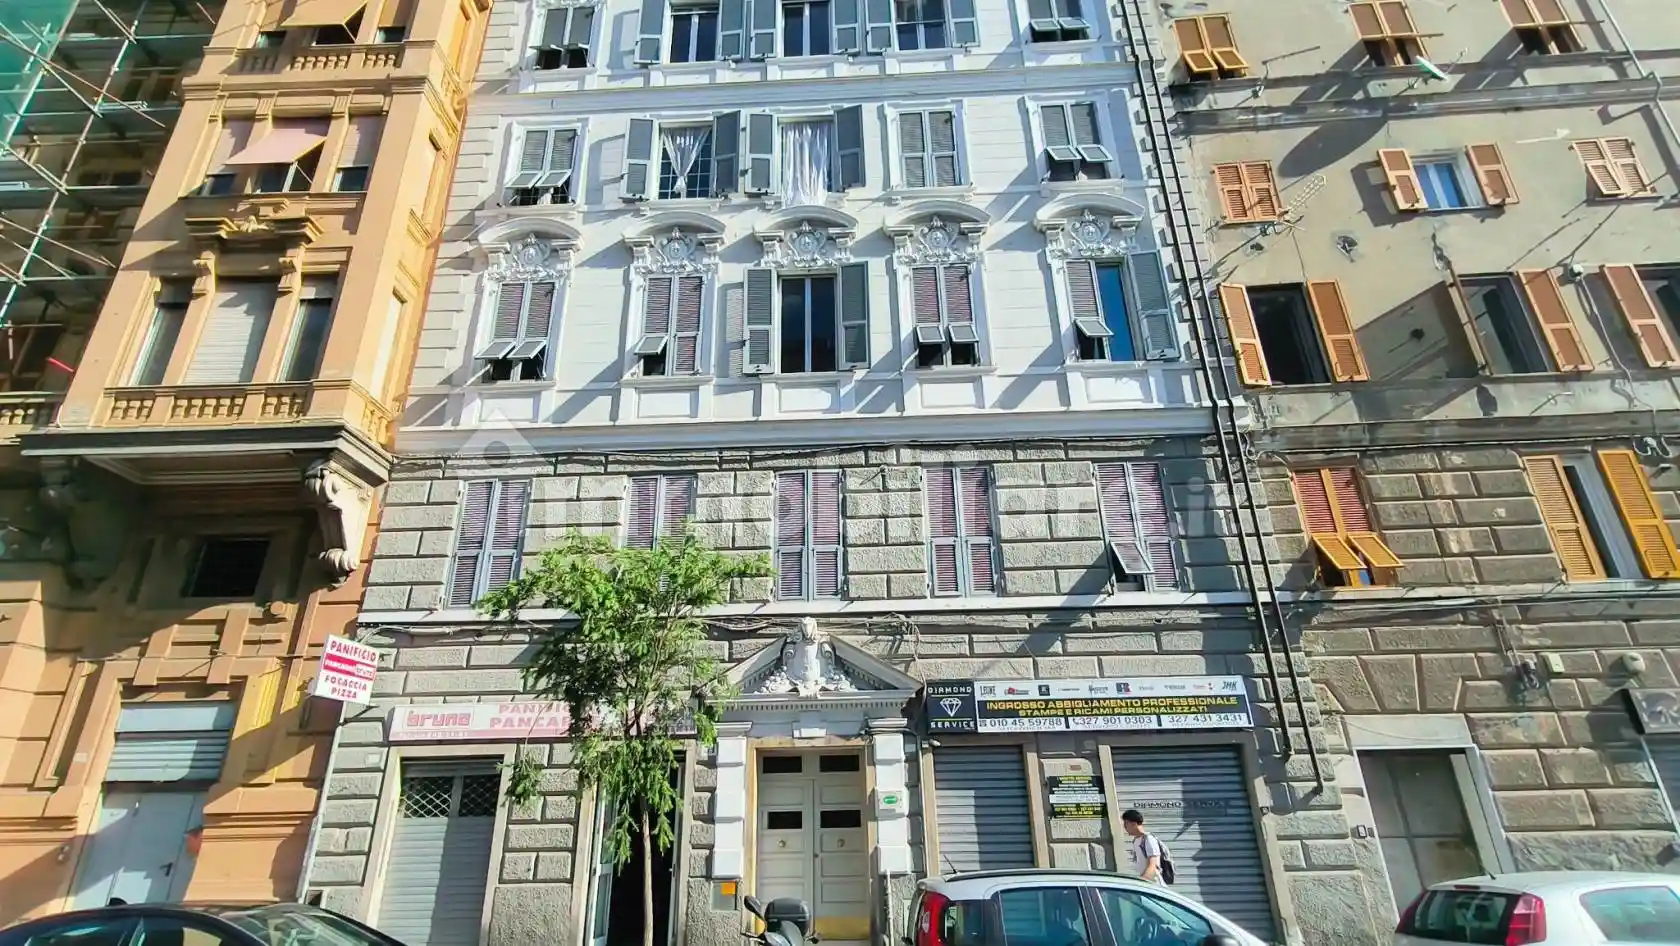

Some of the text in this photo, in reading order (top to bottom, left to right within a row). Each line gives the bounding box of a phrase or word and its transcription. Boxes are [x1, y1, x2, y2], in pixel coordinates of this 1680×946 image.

[330, 640, 377, 662] PANIFICIO
[325, 675, 367, 692] FOCACCIA
[331, 687, 357, 699] PIZZA
[927, 686, 972, 694] DIAMOND
[986, 697, 1238, 710] INGROSSO ABBIGLIAMENTO PROFESSIONALE
[1018, 709, 1064, 717] STAMPE
[1074, 707, 1112, 716] RICAMI
[1114, 706, 1208, 715] PERSONALIZZATI
[989, 718, 1009, 727] 010
[1012, 718, 1025, 726] 45
[1079, 715, 1153, 725] 327 901 0303
[1168, 714, 1243, 723] 327 431 3431
[930, 720, 975, 729] SERVICE
